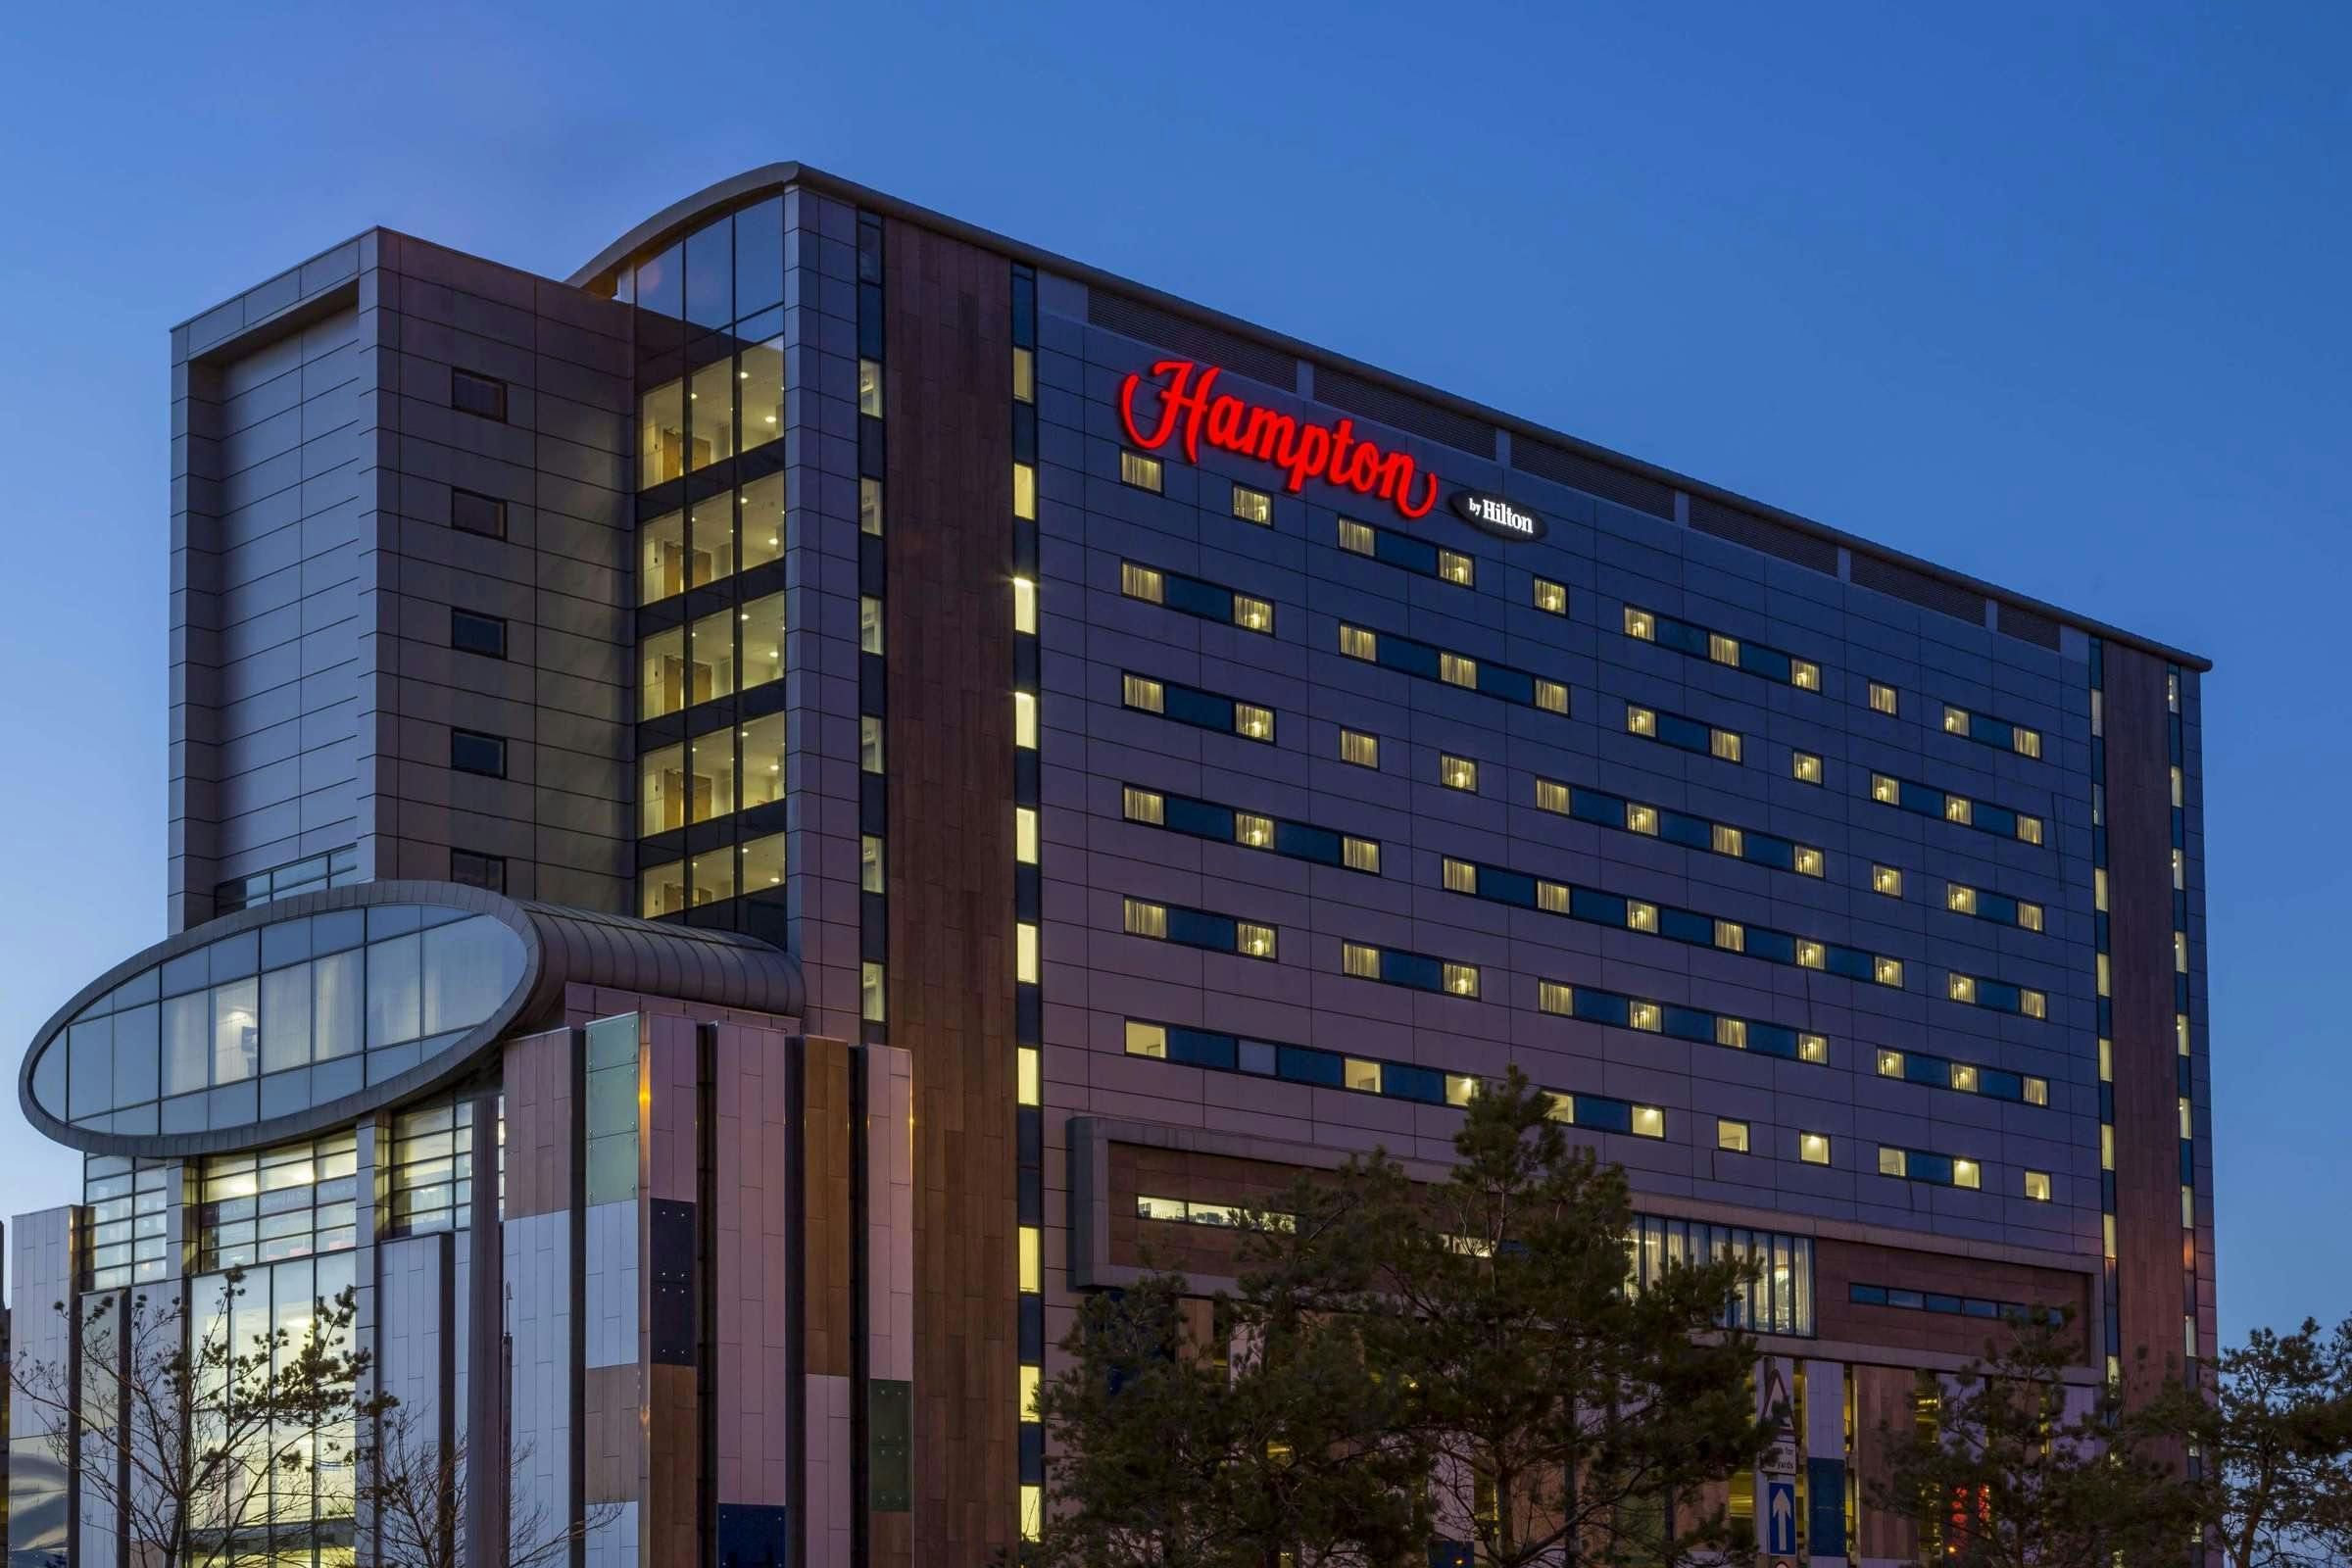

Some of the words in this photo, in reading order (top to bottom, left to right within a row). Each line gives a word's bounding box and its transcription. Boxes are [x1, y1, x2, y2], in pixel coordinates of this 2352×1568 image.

[1121, 360, 1438, 518] Hampton
[1468, 497, 1482, 516] by
[1482, 498, 1534, 534] Hilton
